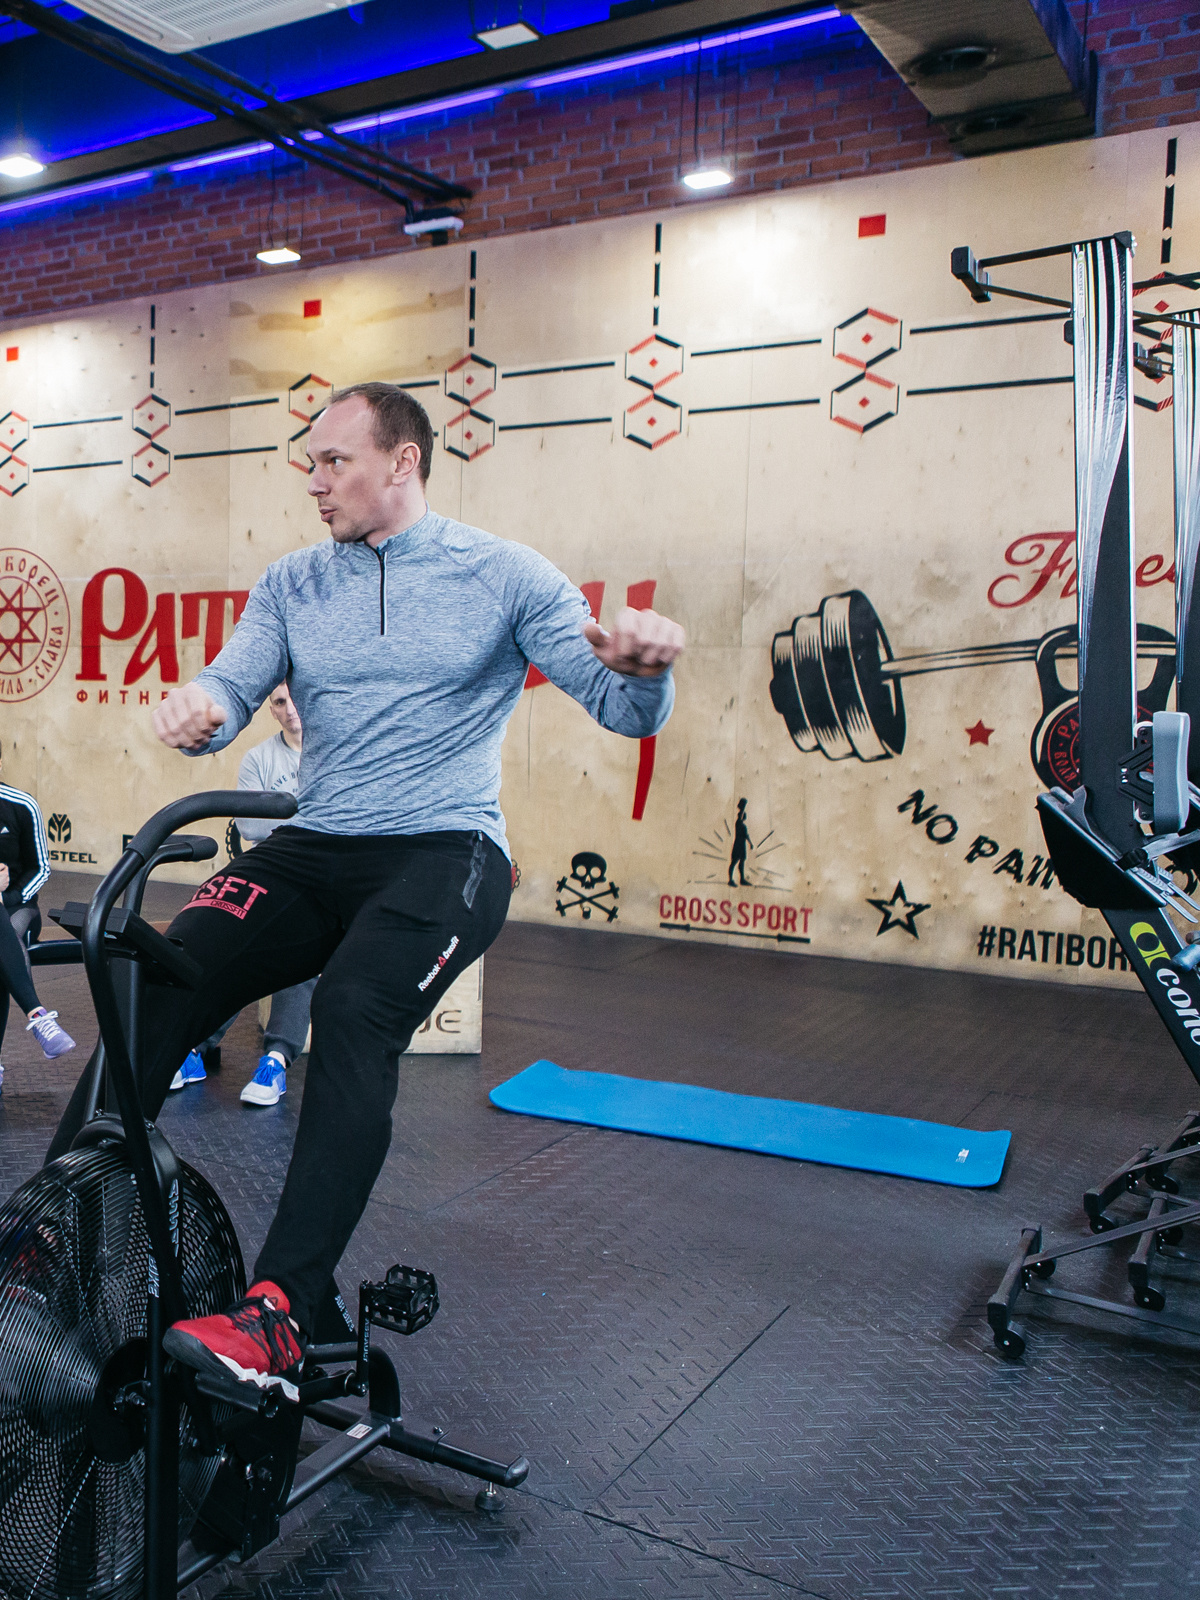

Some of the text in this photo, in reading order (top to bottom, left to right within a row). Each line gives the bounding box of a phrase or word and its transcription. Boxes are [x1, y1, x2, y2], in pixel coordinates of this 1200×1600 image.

[35, 626, 64, 680] СЛАВА
[897, 789, 959, 845] NO
[977, 925, 1137, 973] #RATIBOR
[418, 963, 442, 991] Reebok
